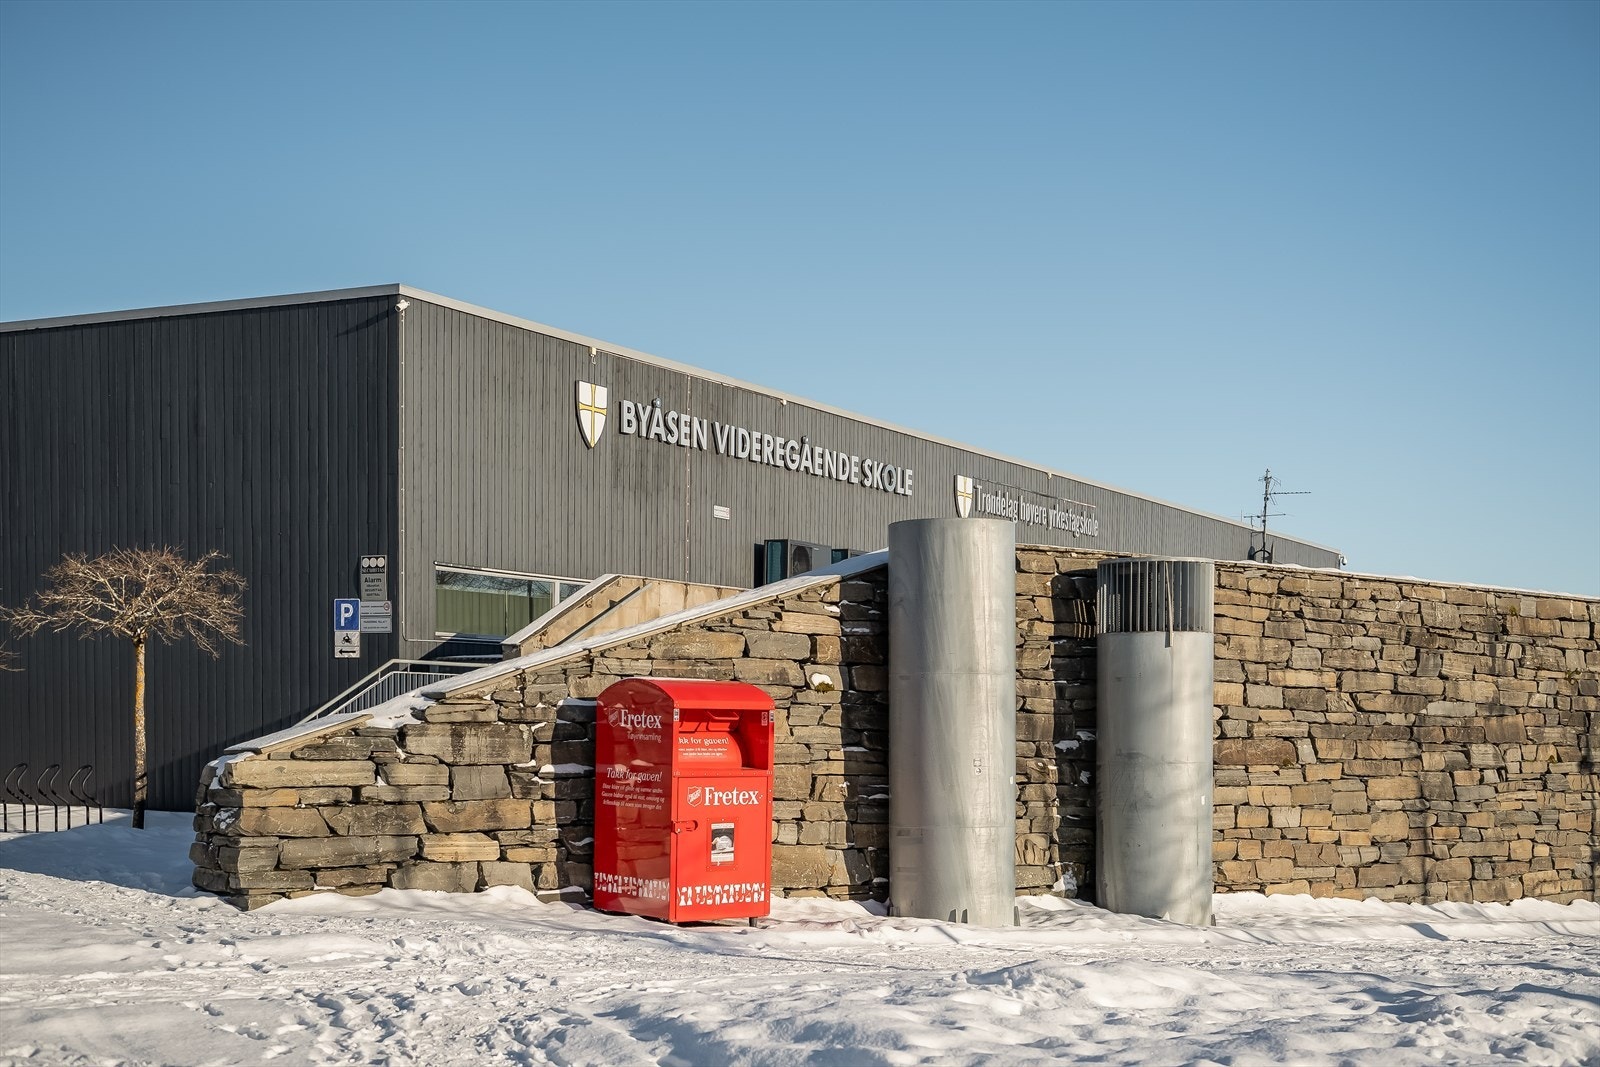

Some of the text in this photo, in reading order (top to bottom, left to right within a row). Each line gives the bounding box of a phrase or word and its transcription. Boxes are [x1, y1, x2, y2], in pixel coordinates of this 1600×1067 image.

[619, 397, 913, 496] BYÅSEN VIDEREGÅENDE SKOLE
[975, 484, 1099, 538] Trøndelag høyere yrkesfagskole
[340, 603, 354, 627] P
[620, 709, 662, 729] Fretex
[678, 736, 729, 747] kk for gaven!
[606, 767, 663, 784] Takk for gaven!
[703, 786, 760, 806] Fretex
